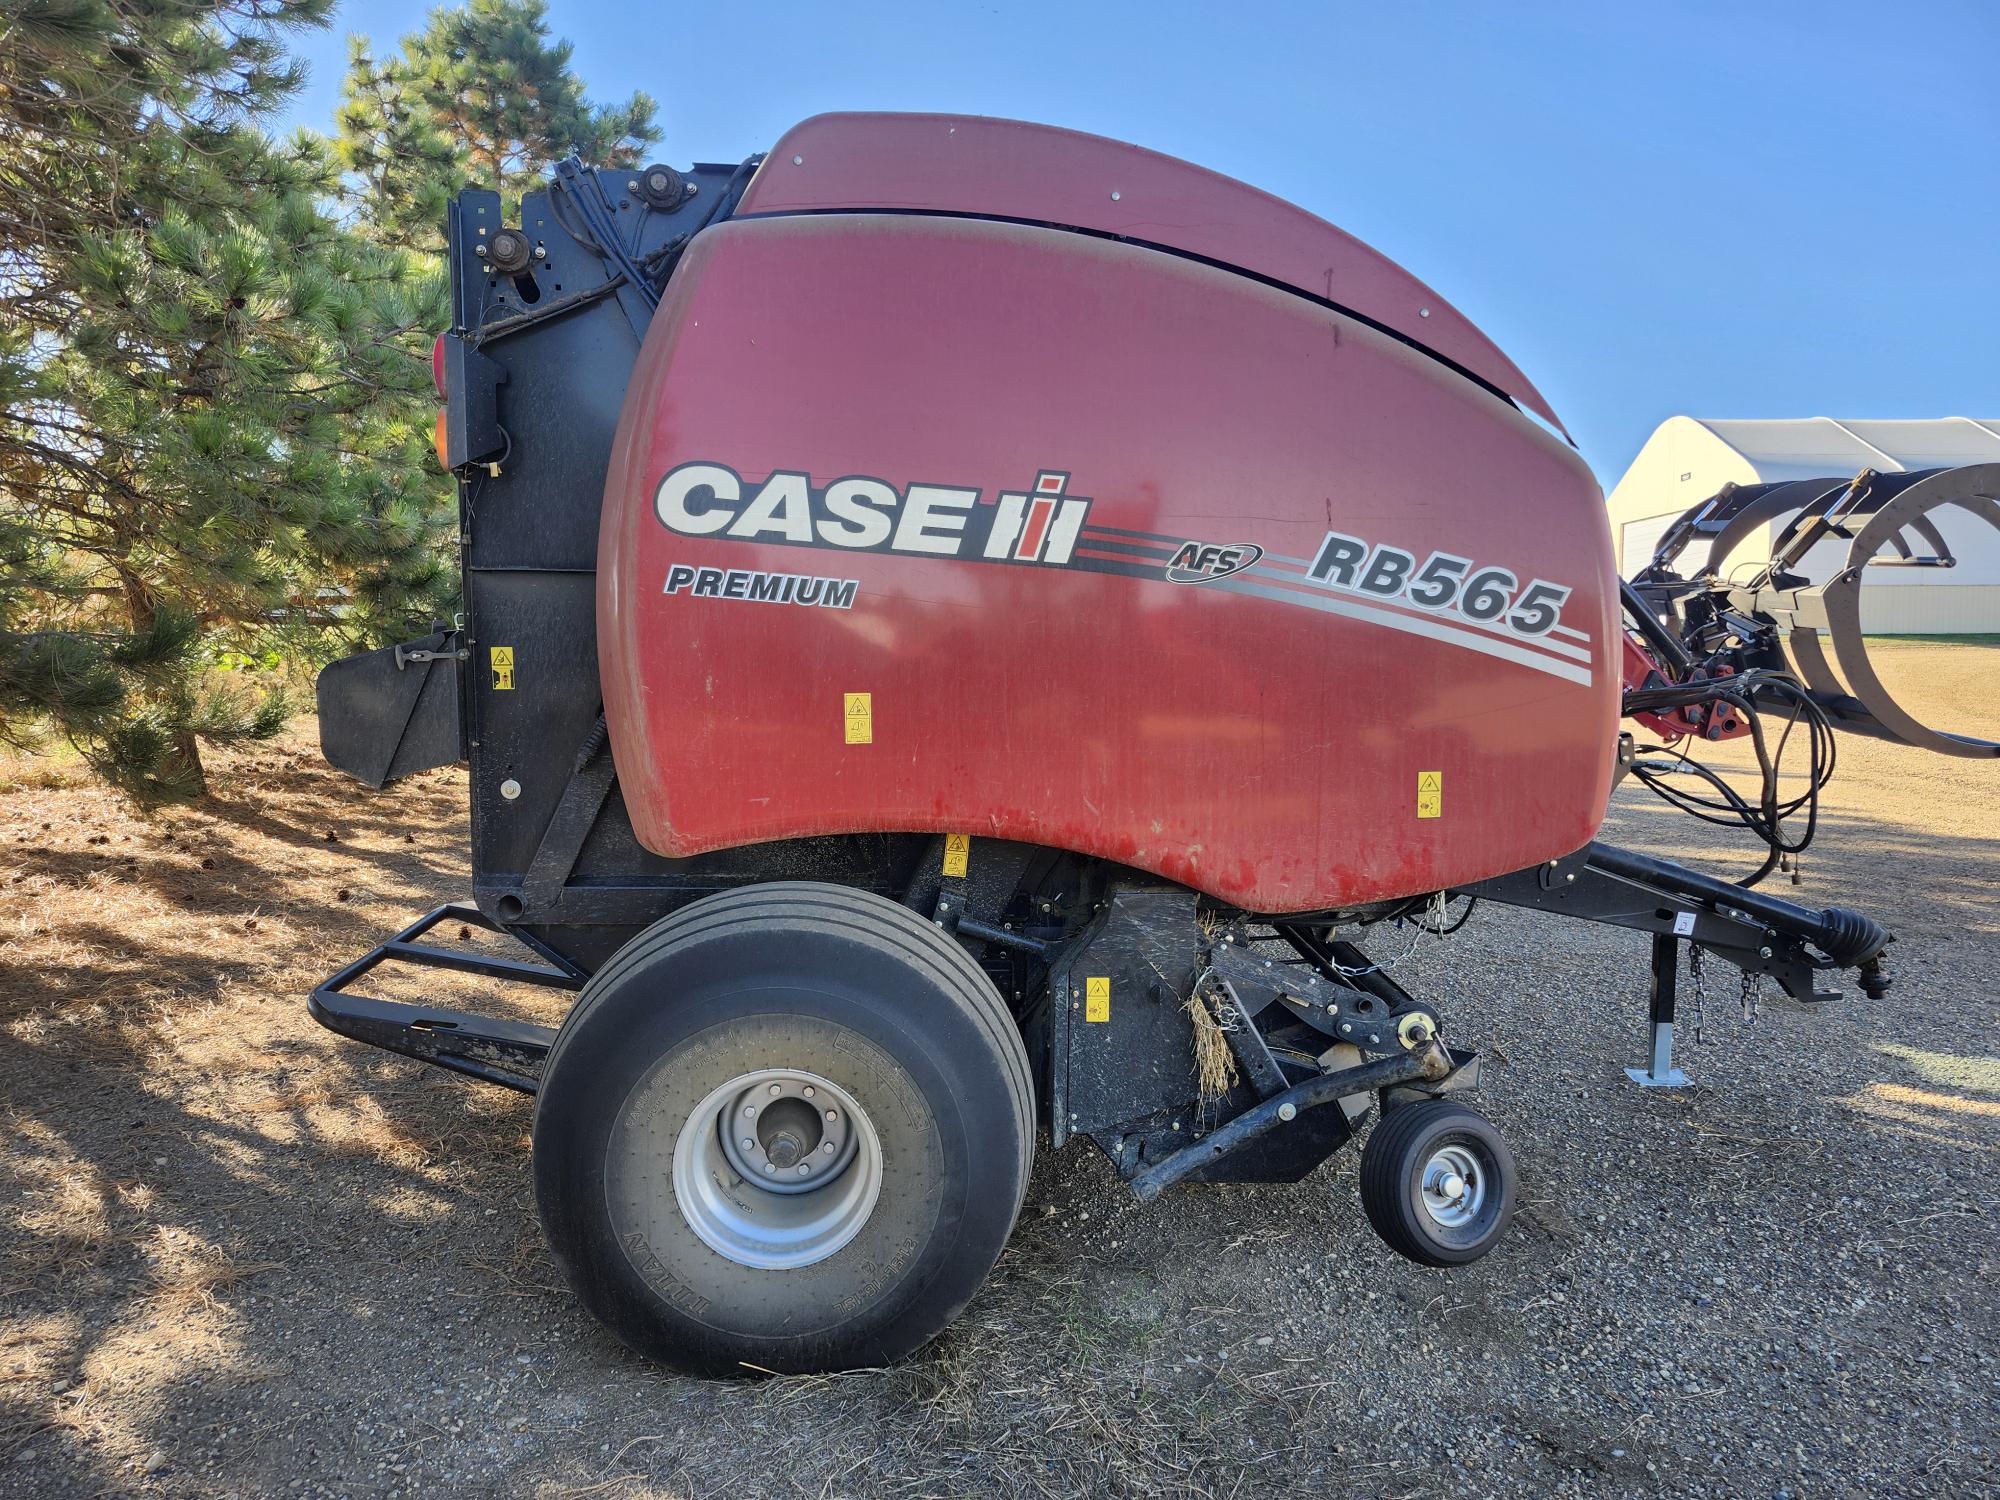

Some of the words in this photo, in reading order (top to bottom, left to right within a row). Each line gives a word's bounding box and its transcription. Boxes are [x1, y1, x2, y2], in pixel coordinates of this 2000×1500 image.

[657, 465, 978, 555] CASE
[664, 564, 859, 609] PREMIUM
[1166, 541, 1244, 576] AFS
[1307, 531, 1573, 638] RB565
[621, 1232, 713, 1316] TITAN
